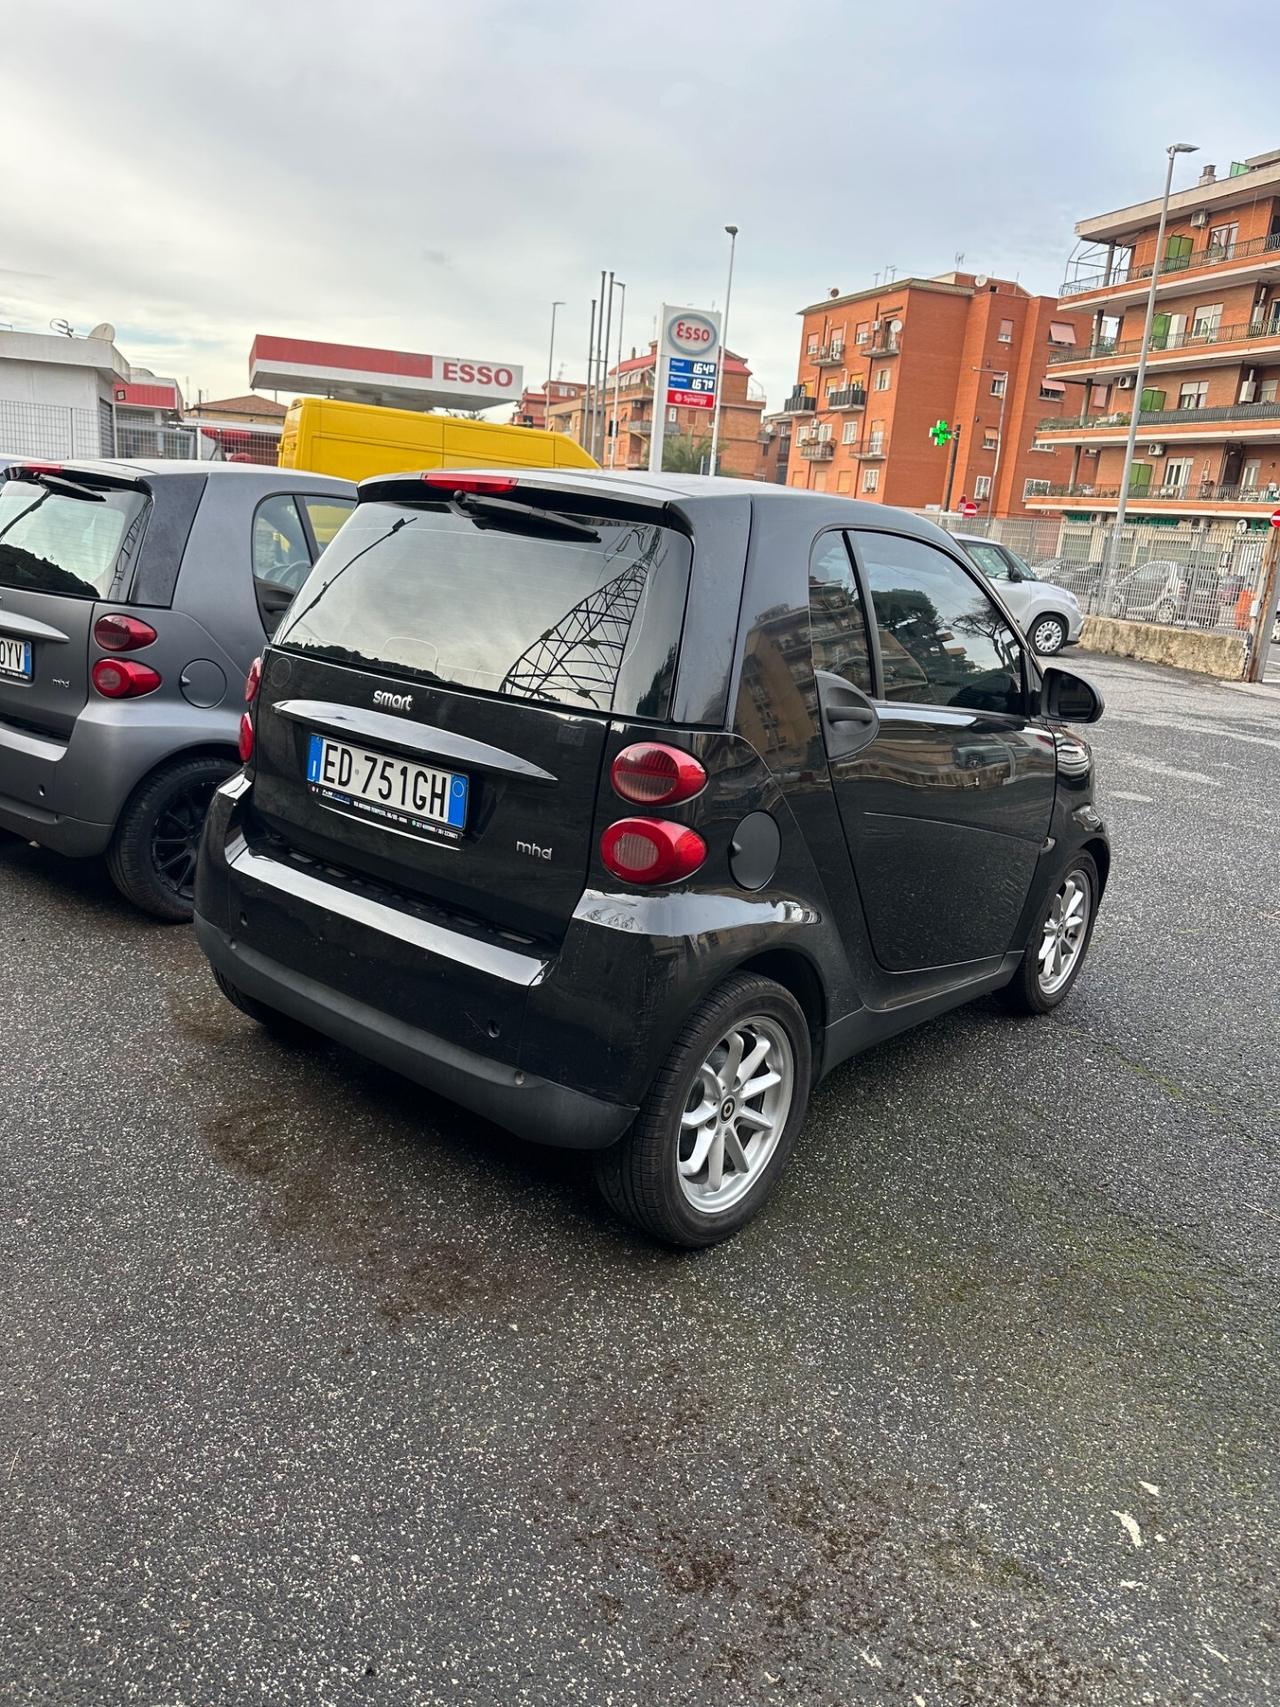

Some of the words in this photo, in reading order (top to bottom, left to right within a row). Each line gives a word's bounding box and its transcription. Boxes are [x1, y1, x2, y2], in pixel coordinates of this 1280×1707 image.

[443, 362, 513, 387] ESSO
[372, 689, 413, 711] smart
[516, 840, 553, 861] mhd
